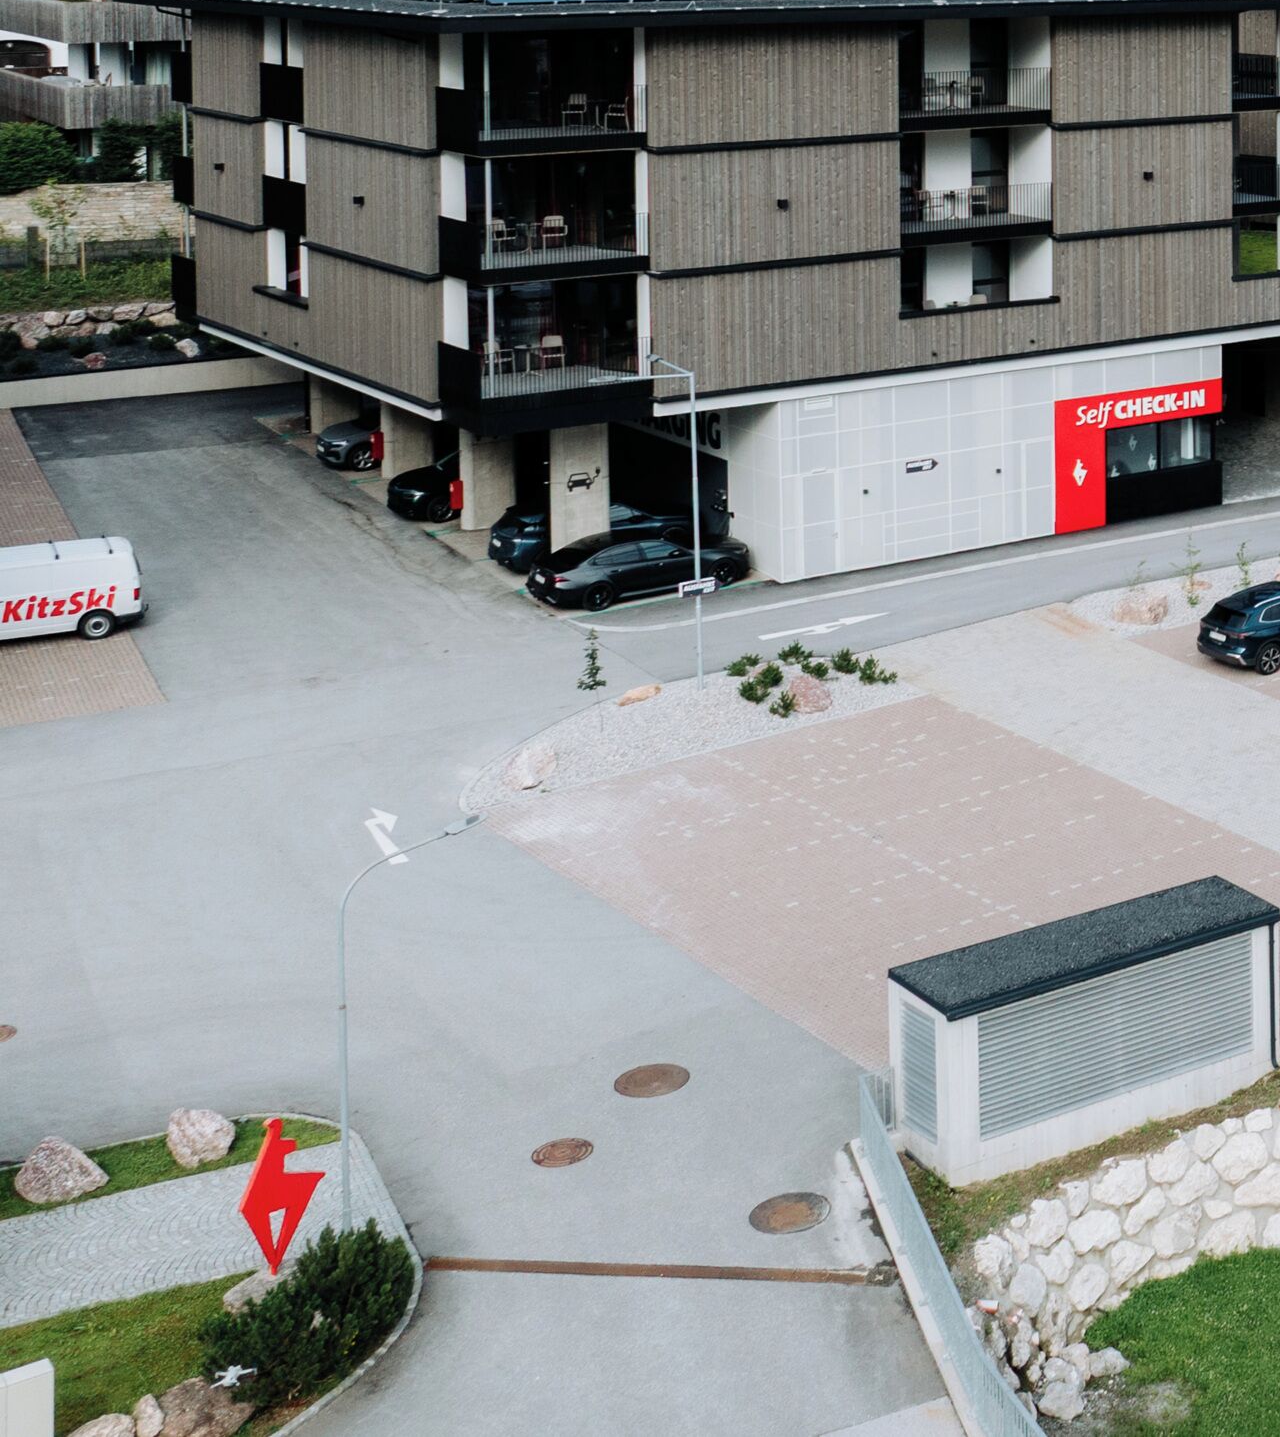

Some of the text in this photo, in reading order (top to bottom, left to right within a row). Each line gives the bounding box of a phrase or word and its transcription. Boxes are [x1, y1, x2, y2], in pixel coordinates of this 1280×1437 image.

[1075, 389, 1206, 429] Self CHECK-IN
[2, 585, 117, 623] KitzSki
